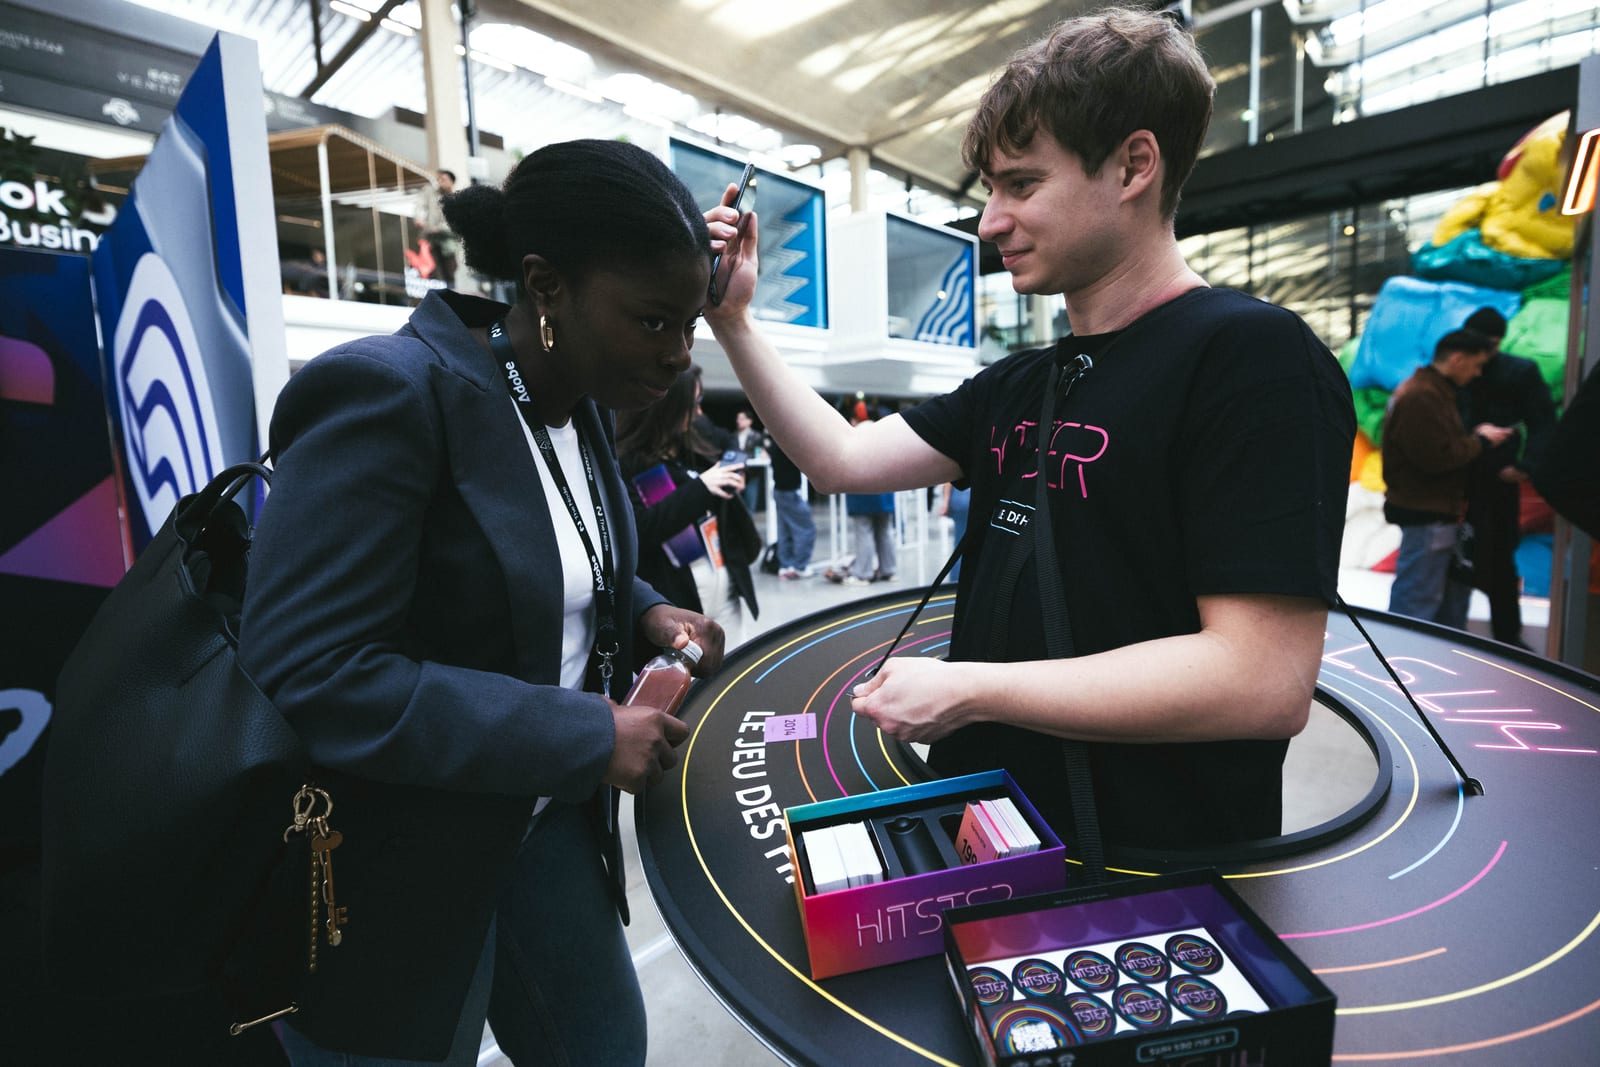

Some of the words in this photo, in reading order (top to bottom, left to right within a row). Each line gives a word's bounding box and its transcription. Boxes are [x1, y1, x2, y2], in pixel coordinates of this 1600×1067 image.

[505, 361, 531, 402] Adobe
[591, 555, 605, 591] Adobe
[738, 711, 776, 733] LE
[784, 719, 797, 736] 2014
[731, 738, 768, 779] JEU
[734, 784, 787, 840] DES
[1172, 946, 1216, 962] HITSTER
[1070, 963, 1114, 980] HITSTER
[1121, 955, 1165, 971] HITSTER
[973, 980, 1009, 995] TSTER
[1017, 972, 1062, 988] HITSTER
[1172, 989, 1220, 1006] HITSTER
[1074, 1007, 1111, 1023] TSTER
[1118, 998, 1166, 1016] HITSTER
